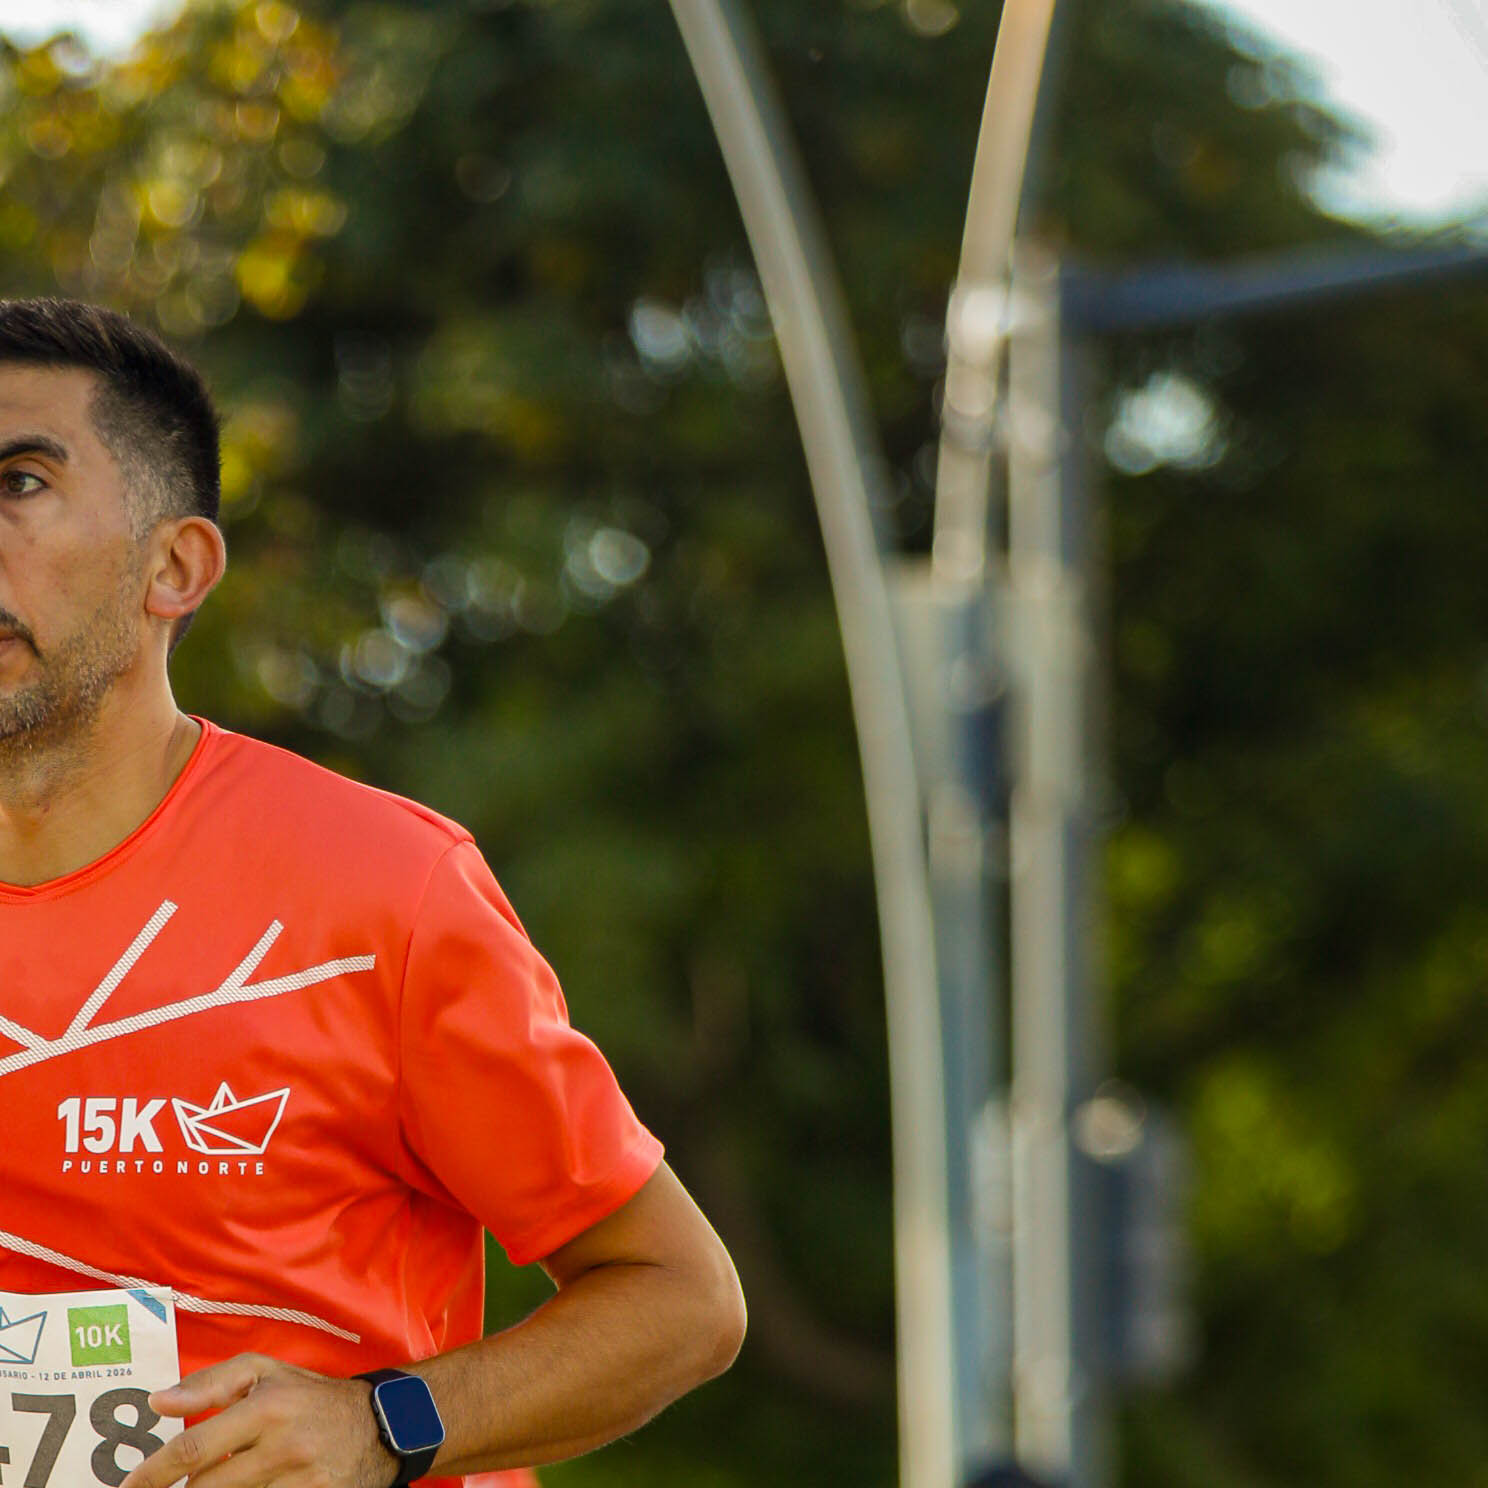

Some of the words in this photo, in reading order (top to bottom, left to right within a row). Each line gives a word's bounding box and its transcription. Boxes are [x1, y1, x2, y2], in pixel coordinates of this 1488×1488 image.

[57, 1097, 167, 1154] 15K
[62, 1160, 164, 1175] PUERTO
[177, 1161, 264, 1176] NORTE
[75, 1323, 124, 1349] 10K
[39, 1372, 49, 1381] 12
[53, 1372, 67, 1380] DE
[71, 1370, 103, 1380] ABRIL
[106, 1368, 133, 1377] 2026
